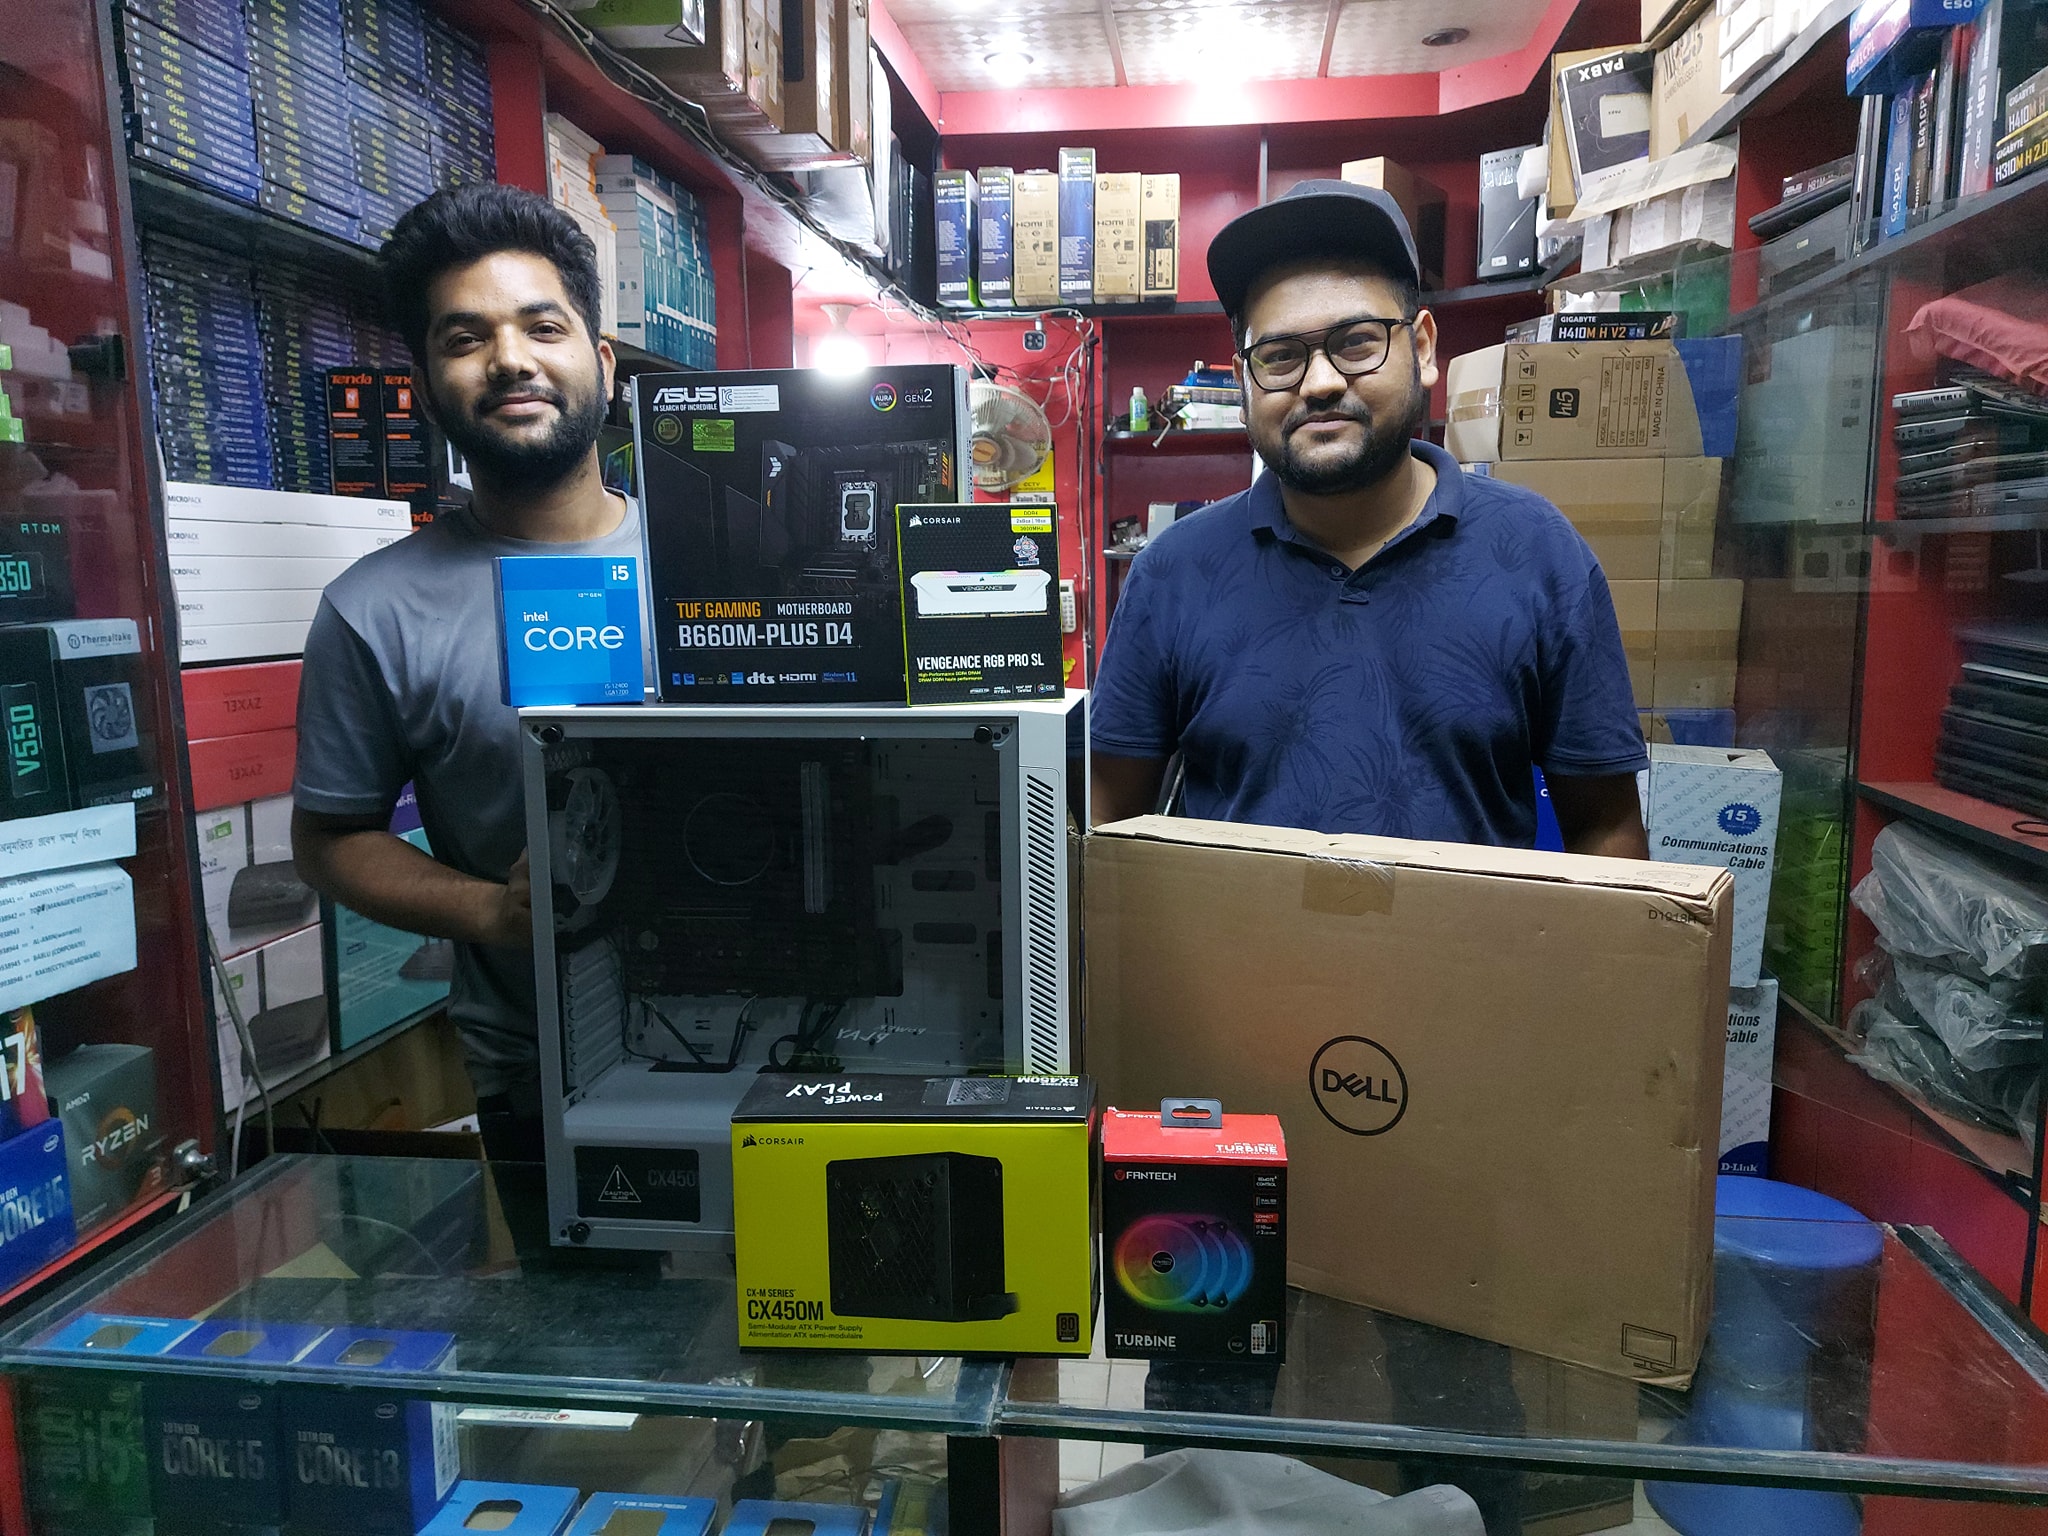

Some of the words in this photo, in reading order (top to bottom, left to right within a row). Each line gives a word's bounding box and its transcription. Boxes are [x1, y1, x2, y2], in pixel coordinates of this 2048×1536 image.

[1578, 57, 1625, 82] PABX
[1561, 315, 1597, 323] GIGABYTE
[1559, 326, 1596, 339] H410M
[1599, 326, 1607, 338] H
[1611, 326, 1627, 338] V2
[331, 373, 373, 385] Tenda
[1656, 366, 1665, 396] CHINA
[653, 386, 717, 404] ASUS
[875, 394, 893, 402] AURA
[653, 404, 659, 412] IN
[660, 404, 679, 412] SEARCH
[687, 403, 718, 411] INCREDIBLE
[1655, 398, 1662, 408] IN
[1653, 410, 1662, 437] MADE
[923, 517, 961, 525] CORSAIR
[20, 522, 61, 535] ATOM
[611, 564, 630, 581] i5
[523, 611, 549, 622] intel
[676, 602, 702, 619] TUF
[705, 601, 762, 618] GAMING
[777, 602, 852, 616] MOTHERBOARD
[81, 631, 133, 646] Thermaltake
[678, 622, 819, 647] B660M-PLUS
[825, 622, 853, 645] D4
[916, 655, 981, 671] VENGEANCE
[984, 654, 1005, 668] RGB
[1008, 653, 1028, 667] PRO
[1031, 653, 1045, 666] SL
[746, 671, 776, 685] dts
[779, 673, 818, 682] HDMI
[10, 703, 41, 776] V550
[132, 786, 154, 800] 450W
[1725, 809, 1748, 822] 15
[1661, 835, 1769, 856] Communications
[1729, 856, 1766, 870] Cable
[786, 1082, 851, 1098] PLAY
[1322, 1069, 1398, 1105] DELL
[821, 1093, 883, 1105] POWER
[81, 1113, 150, 1166] RYZEN
[759, 1137, 805, 1145] CORSAIR
[1215, 1143, 1278, 1154] TURBINE
[1720, 1161, 1758, 1173] D-Link
[1126, 1171, 1177, 1181] FANTECH
[746, 1288, 766, 1297] CX-M
[768, 1288, 794, 1298] SERIES
[747, 1299, 824, 1321] CX450M
[838, 1324, 863, 1332] Supply
[1115, 1334, 1177, 1348] TURBINE
[163, 1434, 234, 1478] CORE
[237, 1440, 265, 1480] i5
[298, 1444, 369, 1488] CORE
[374, 1450, 401, 1488] i3
